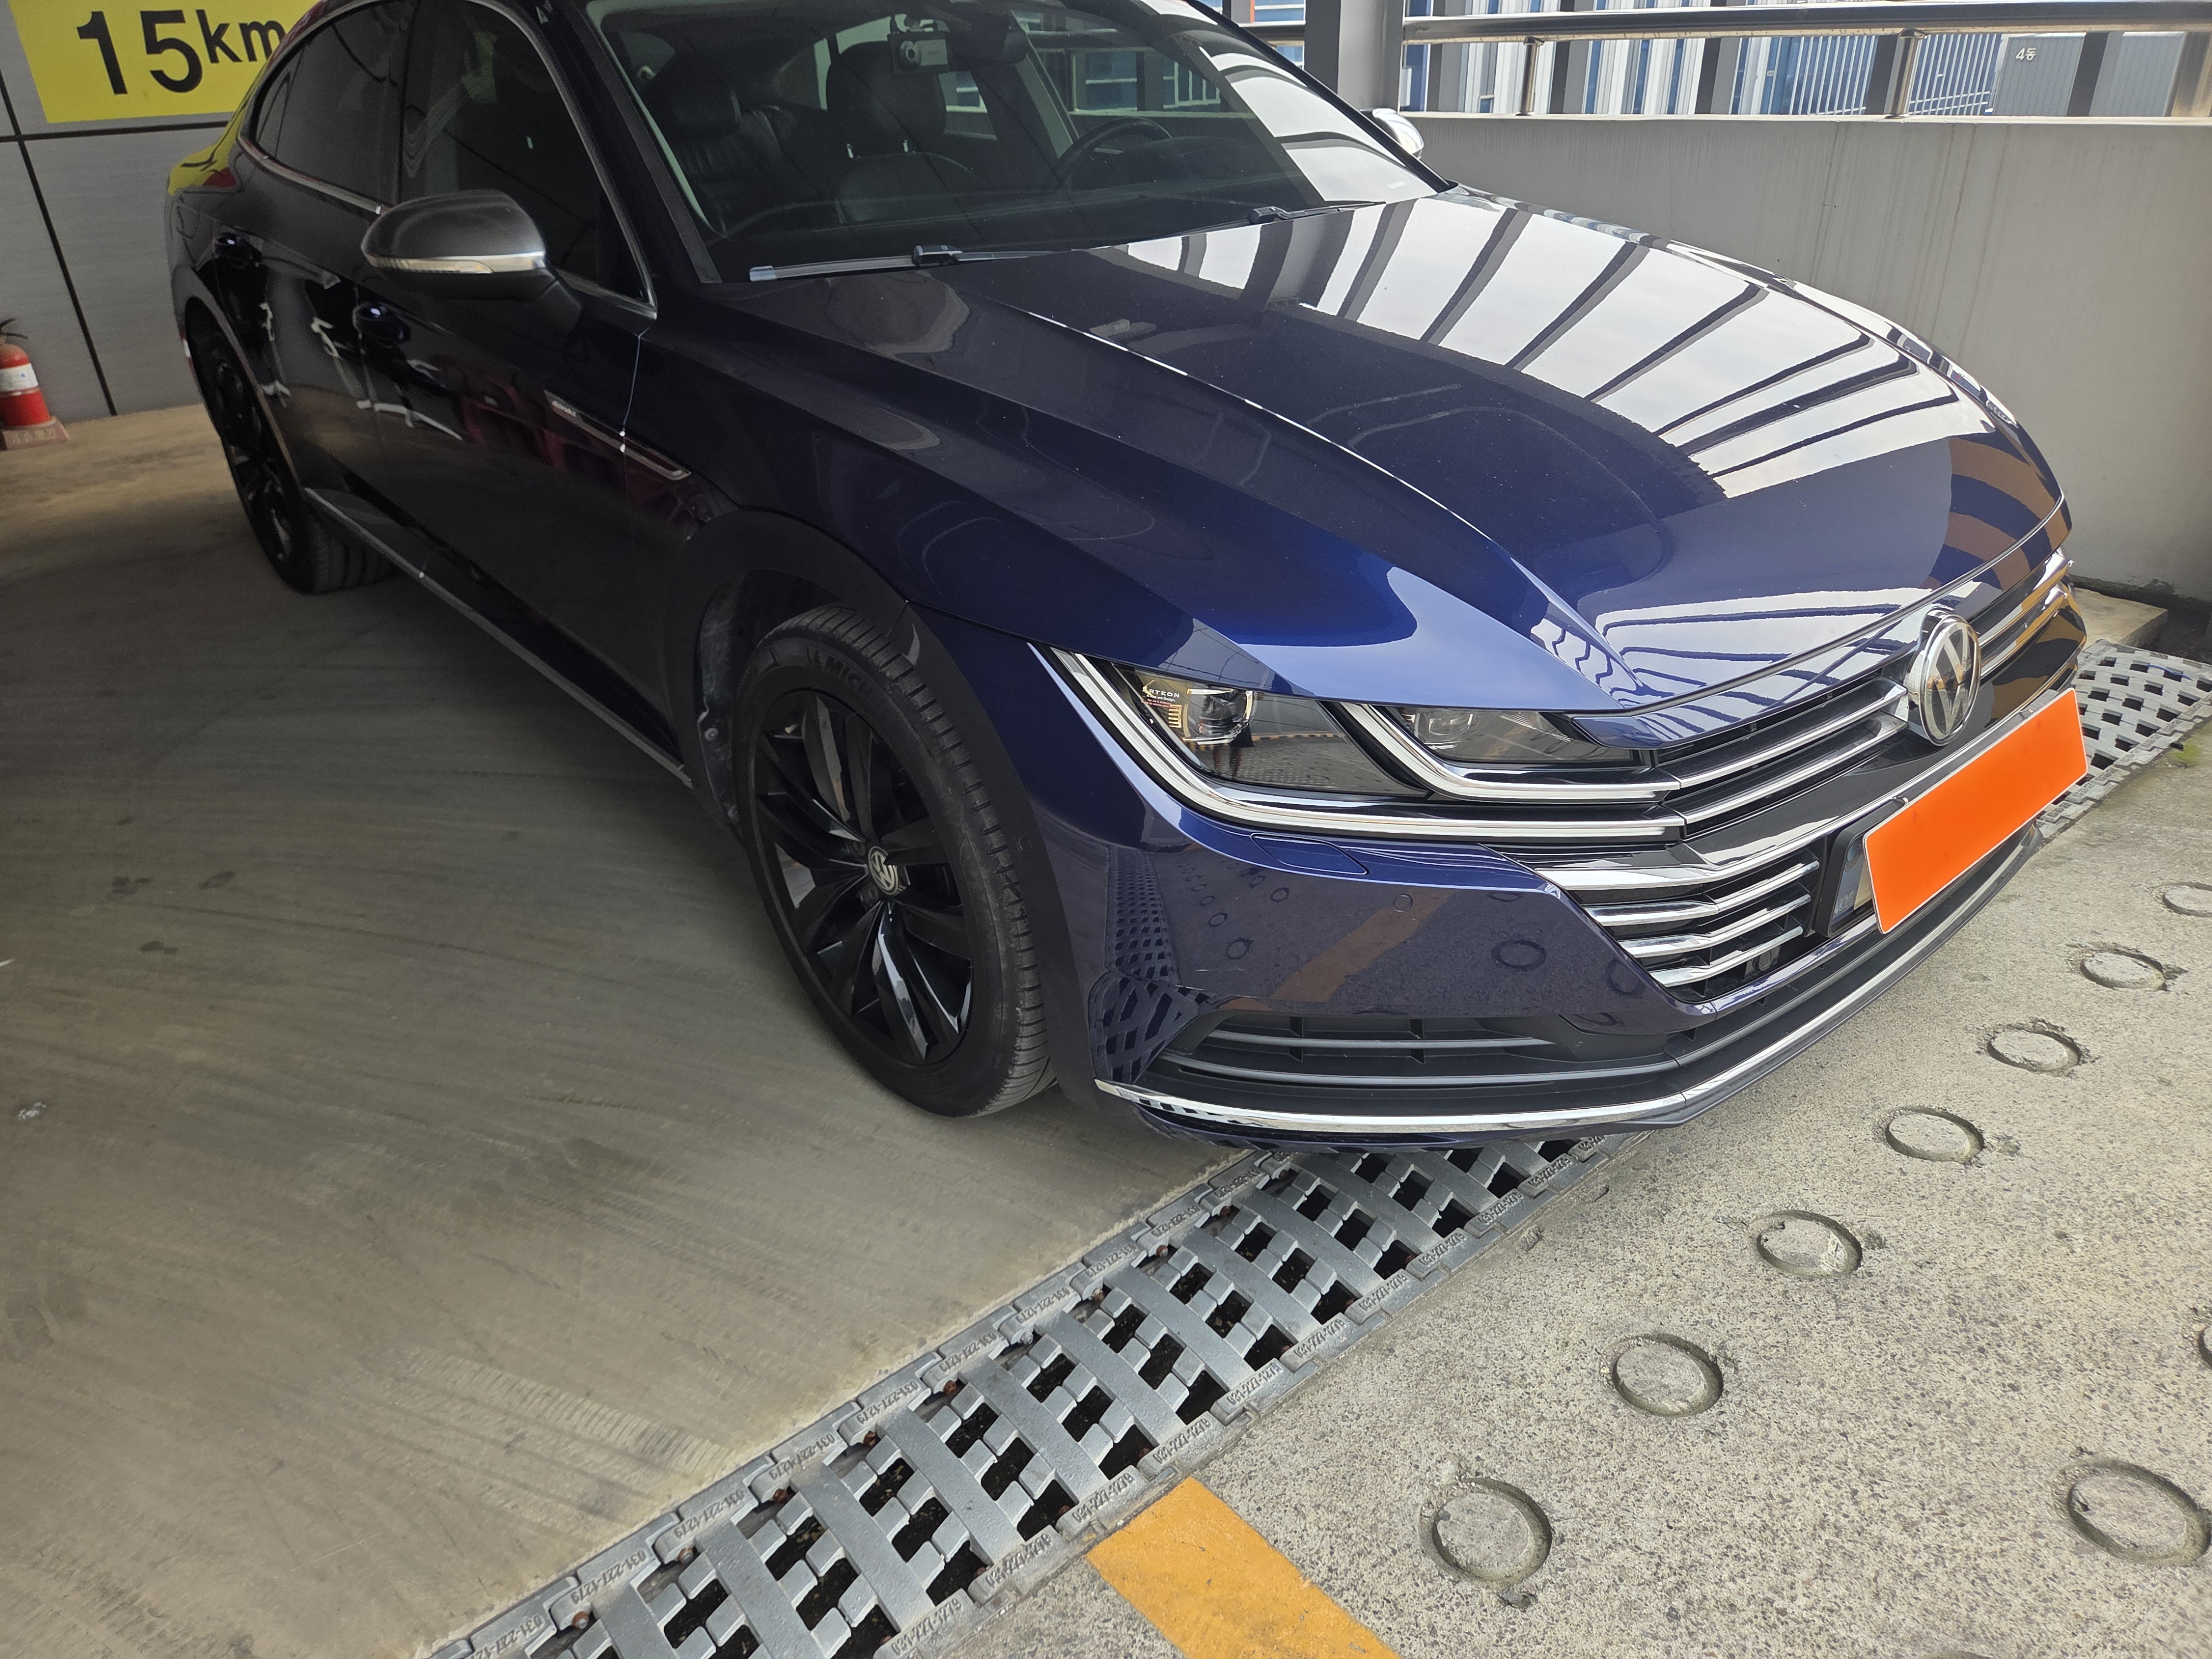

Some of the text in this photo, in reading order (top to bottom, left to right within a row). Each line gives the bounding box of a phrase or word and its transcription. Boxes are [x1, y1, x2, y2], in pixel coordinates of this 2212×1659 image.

[2015, 48, 2036, 61] 4동
[1142, 688, 1180, 698] RTEON
[1015, 1287, 1071, 1324] 031-227-1279
[939, 1332, 998, 1373] 031-227-1279
[857, 1380, 919, 1425] 031-227-1279
[768, 1433, 836, 1480] 031-227-1279
[674, 1488, 745, 1539] 031-227-1279
[570, 1550, 647, 1604] 031-227-1279
[470, 1614, 544, 1659] 031-227-12
